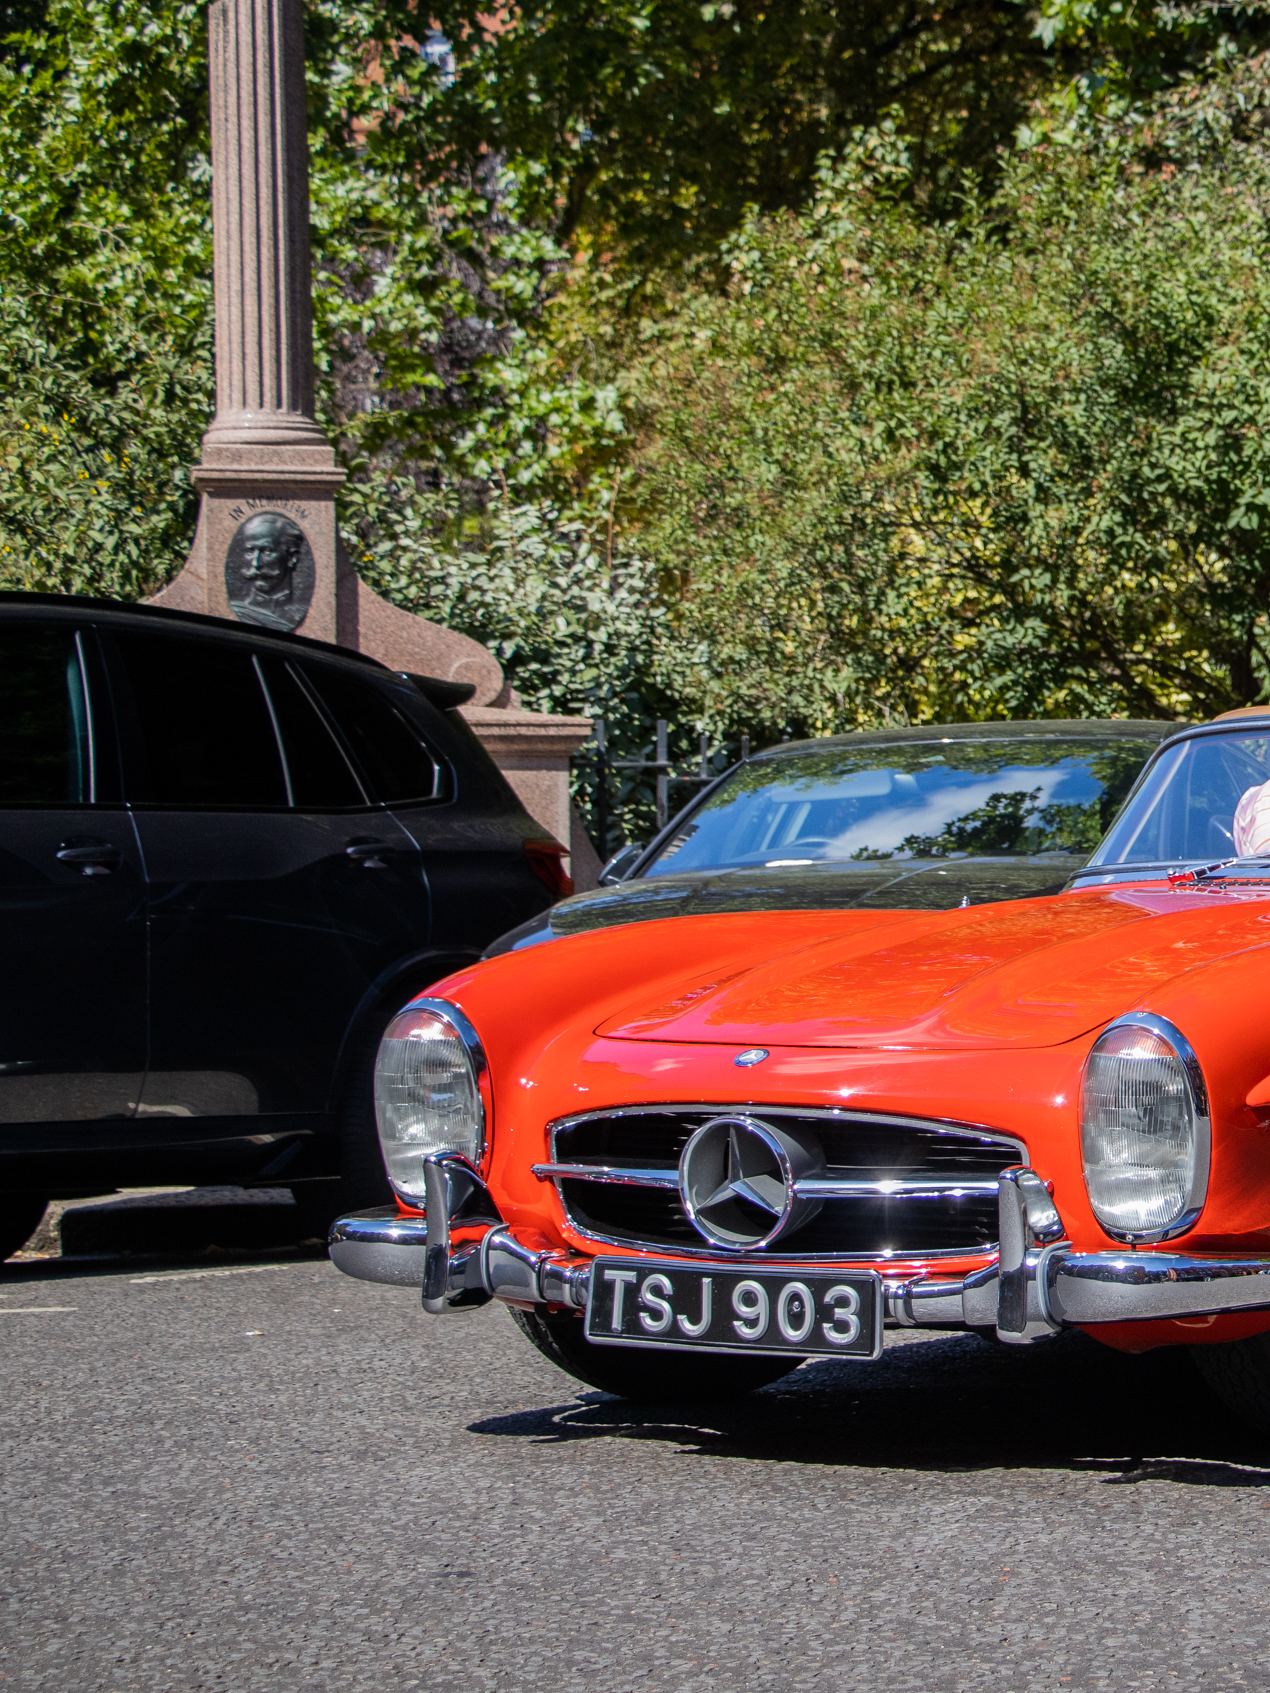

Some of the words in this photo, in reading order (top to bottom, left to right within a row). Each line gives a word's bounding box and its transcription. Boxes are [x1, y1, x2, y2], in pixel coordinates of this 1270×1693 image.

[228, 505, 246, 521] IN
[604, 1269, 713, 1338] TSJ
[731, 1279, 861, 1346] 903
